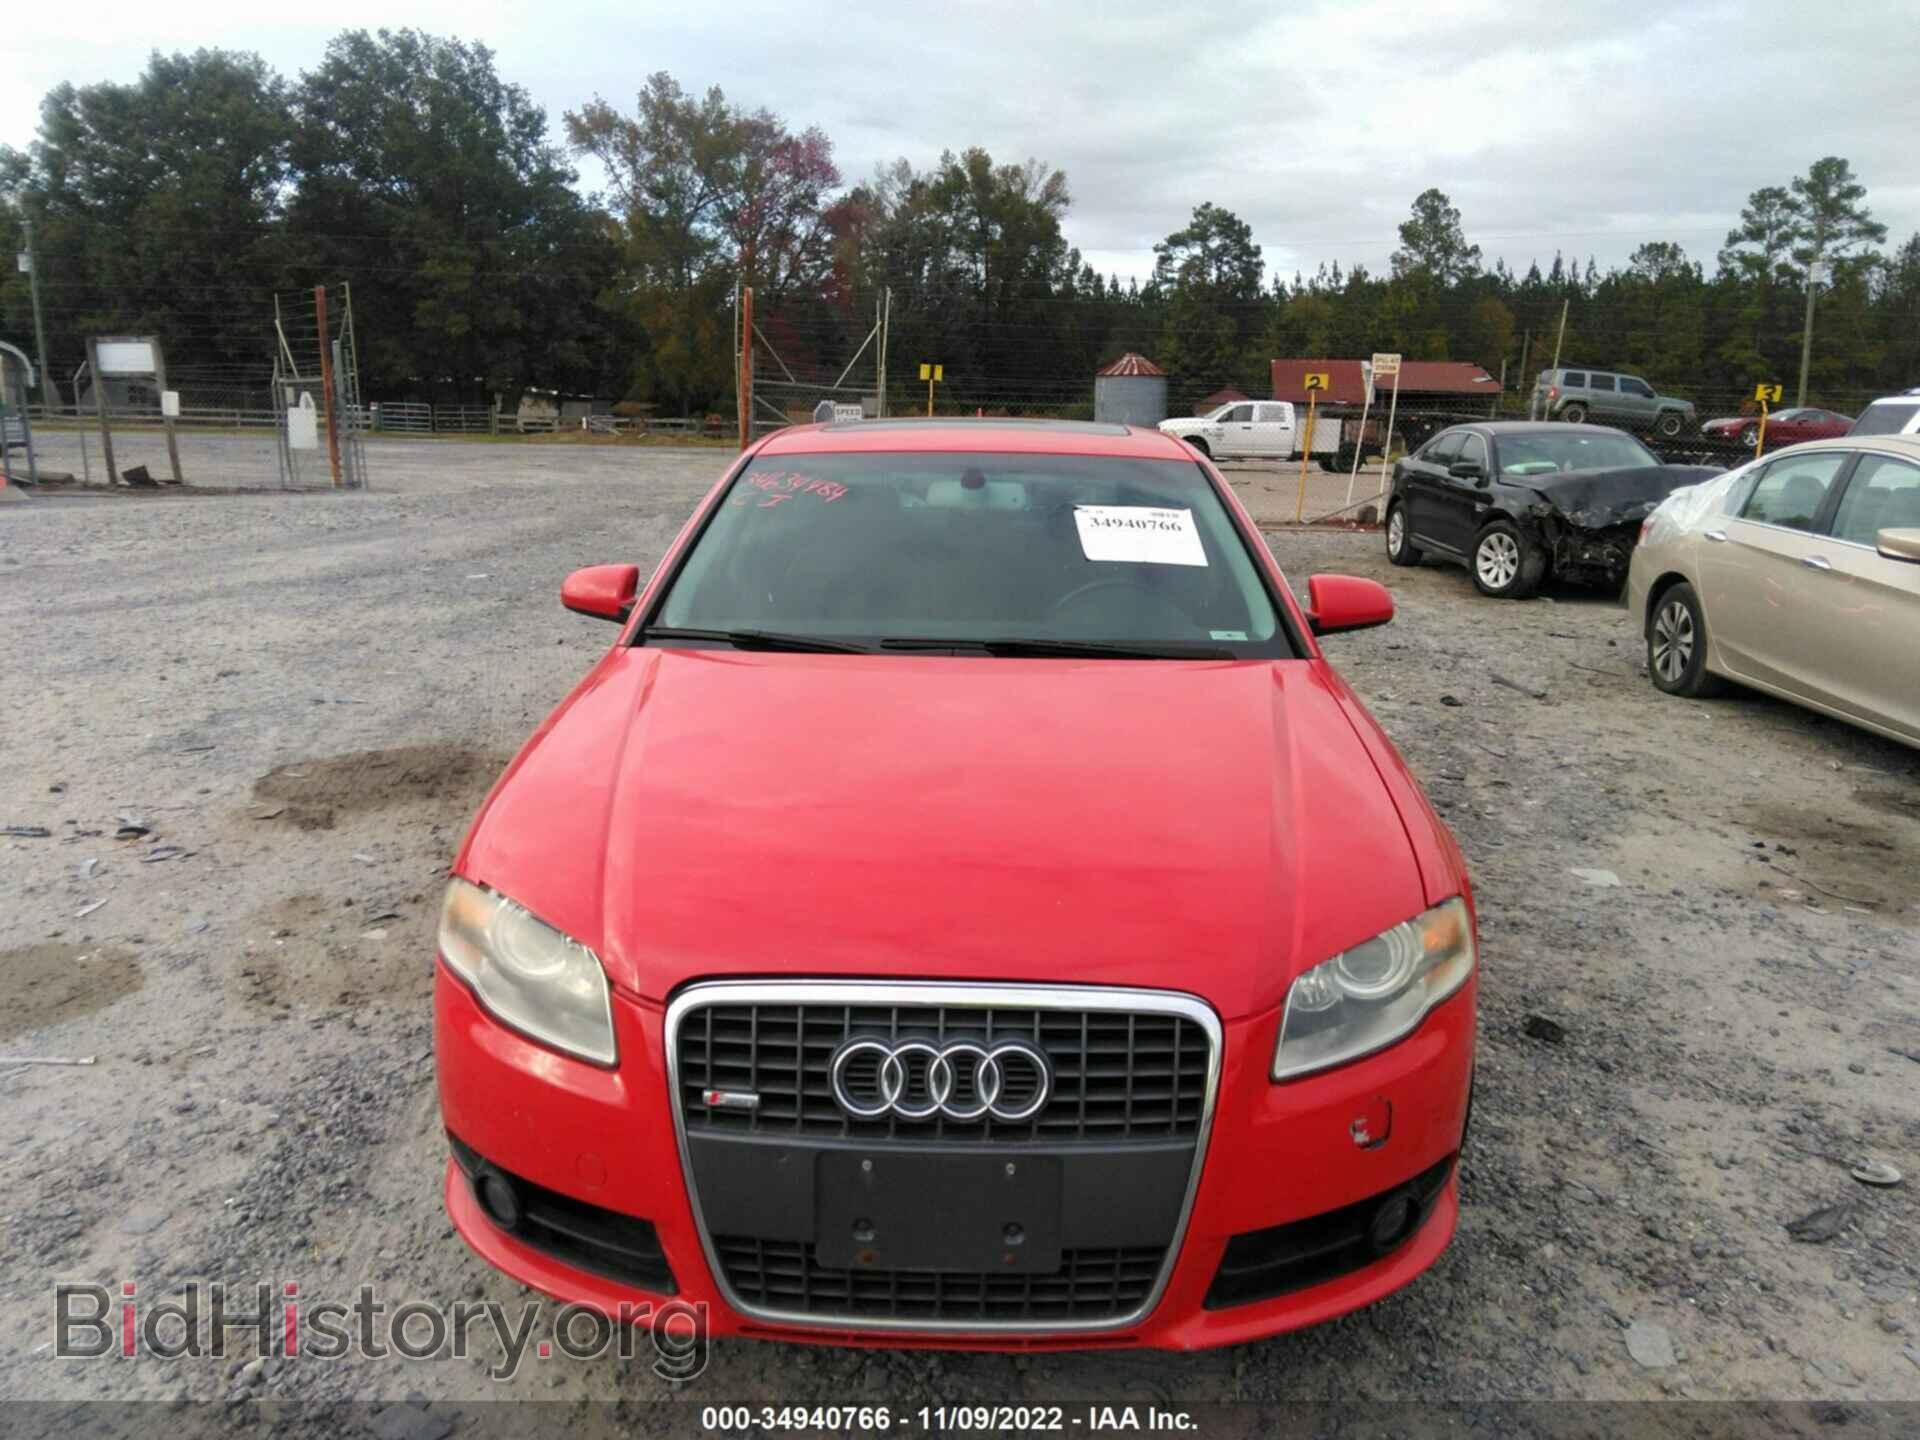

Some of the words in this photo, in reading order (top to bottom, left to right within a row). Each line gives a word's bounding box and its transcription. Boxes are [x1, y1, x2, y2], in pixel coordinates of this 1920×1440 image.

[1308, 376, 1324, 390] 2
[1763, 384, 1776, 400] 3
[836, 408, 860, 416] SPEED
[1089, 516, 1183, 532] 34940766
